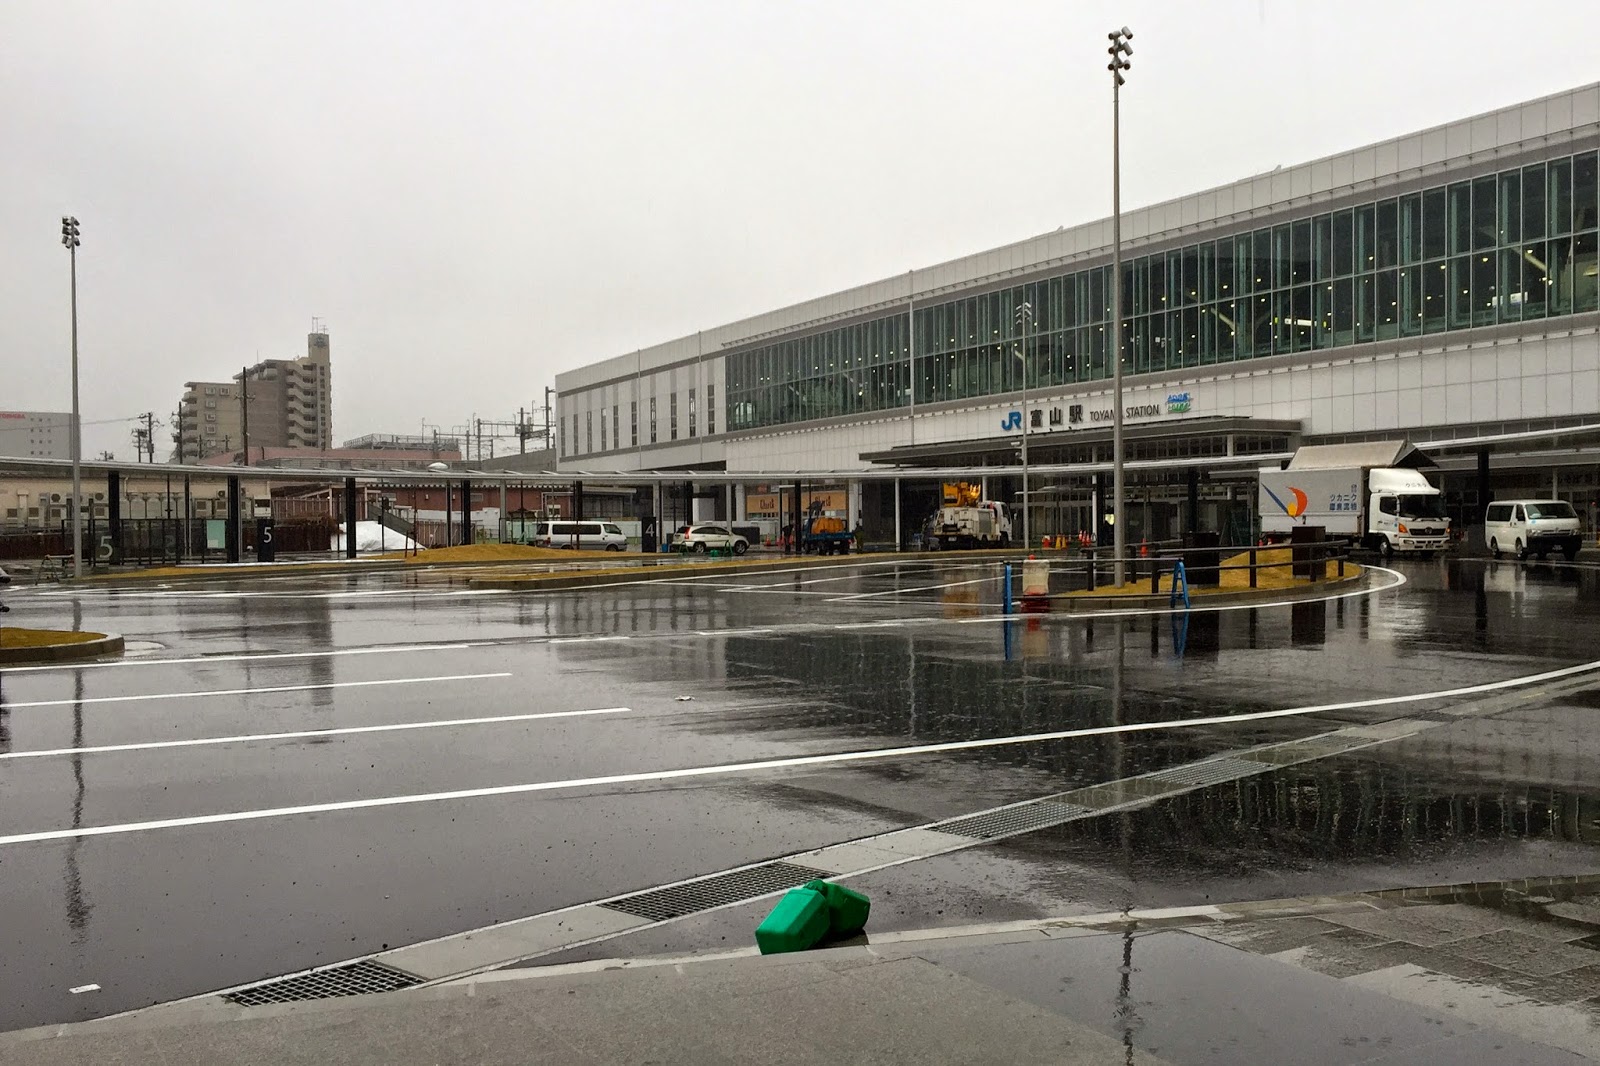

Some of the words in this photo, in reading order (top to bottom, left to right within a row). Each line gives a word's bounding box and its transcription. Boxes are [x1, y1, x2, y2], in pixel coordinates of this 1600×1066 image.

[1002, 411, 1022, 431] JR
[1030, 404, 1084, 429] 富山駅
[1090, 409, 1122, 422] TOYAM
[1125, 404, 1160, 419] STATION
[263, 527, 272, 543] 5
[645, 523, 655, 537] 4
[100, 535, 113, 558] 5
